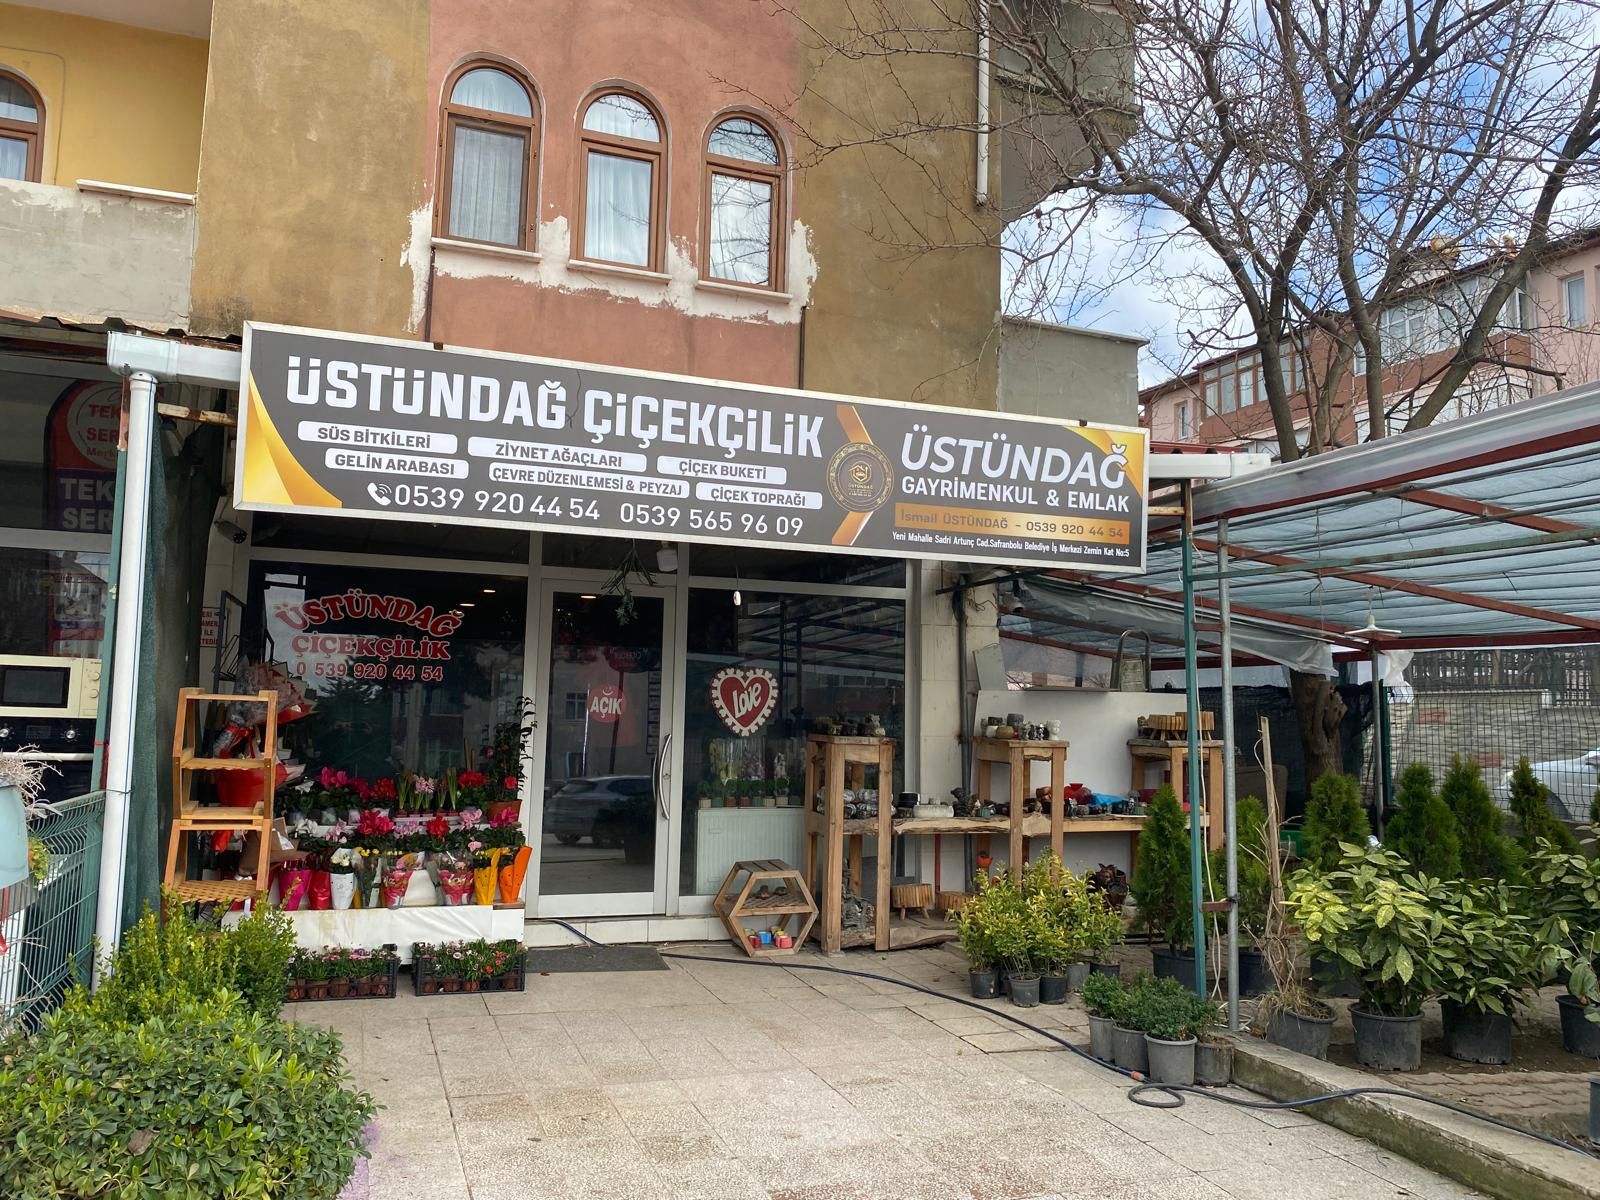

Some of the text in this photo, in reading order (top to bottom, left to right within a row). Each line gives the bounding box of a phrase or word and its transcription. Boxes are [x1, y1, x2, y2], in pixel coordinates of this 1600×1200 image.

[88, 403, 120, 418] TEK
[287, 355, 824, 459] ÜSTÜNDAĞ ÇİÇEKÇİLİK
[86, 427, 118, 442] SER
[317, 426, 431, 449] SÜS BİTKİLERİ
[335, 453, 455, 475] GELİN ARABASI
[496, 441, 622, 469] ZİYNET AĞAÇLARI
[901, 423, 1129, 490] ÜSTÜNDAĞ
[492, 467, 682, 497] ÇEVRE DÜZENLEMESİ & PEYZAJ
[678, 460, 767, 480] ÇİÇEK BUKETİ
[60, 477, 113, 501] TEK
[395, 484, 600, 520] 0539 920 44 54
[711, 486, 806, 507] ÇİÇEK TOPRAĞI
[902, 476, 1038, 506] GAYRİMENKUL
[1046, 489, 1060, 507] &
[1067, 491, 1130, 513] EMLAK
[62, 507, 112, 530] SER
[620, 502, 804, 537] 0539 565 96 09
[943, 512, 1008, 529] ÜSTÜNDAĞ
[1026, 521, 1057, 533] 0539
[1061, 524, 1084, 535] 920
[1089, 526, 1104, 537] 44
[1109, 527, 1123, 538] 54
[892, 531, 906, 541] Yeni
[908, 532, 933, 543] Mahalle
[934, 535, 951, 545] Sadri
[953, 536, 974, 548] Artunç
[1024, 542, 1050, 553] Belediye
[1059, 544, 1082, 554] Merkezi
[1083, 546, 1102, 556] Zemin
[1103, 548, 1114, 557] Kat
[273, 588, 465, 638] ÜSTÜNDAĞ
[291, 631, 451, 662] ÇİÇEKÇİLİK
[297, 662, 443, 682] 0 539 920 44 54
[590, 696, 622, 718] AÇIK
[732, 682, 762, 719] Love
